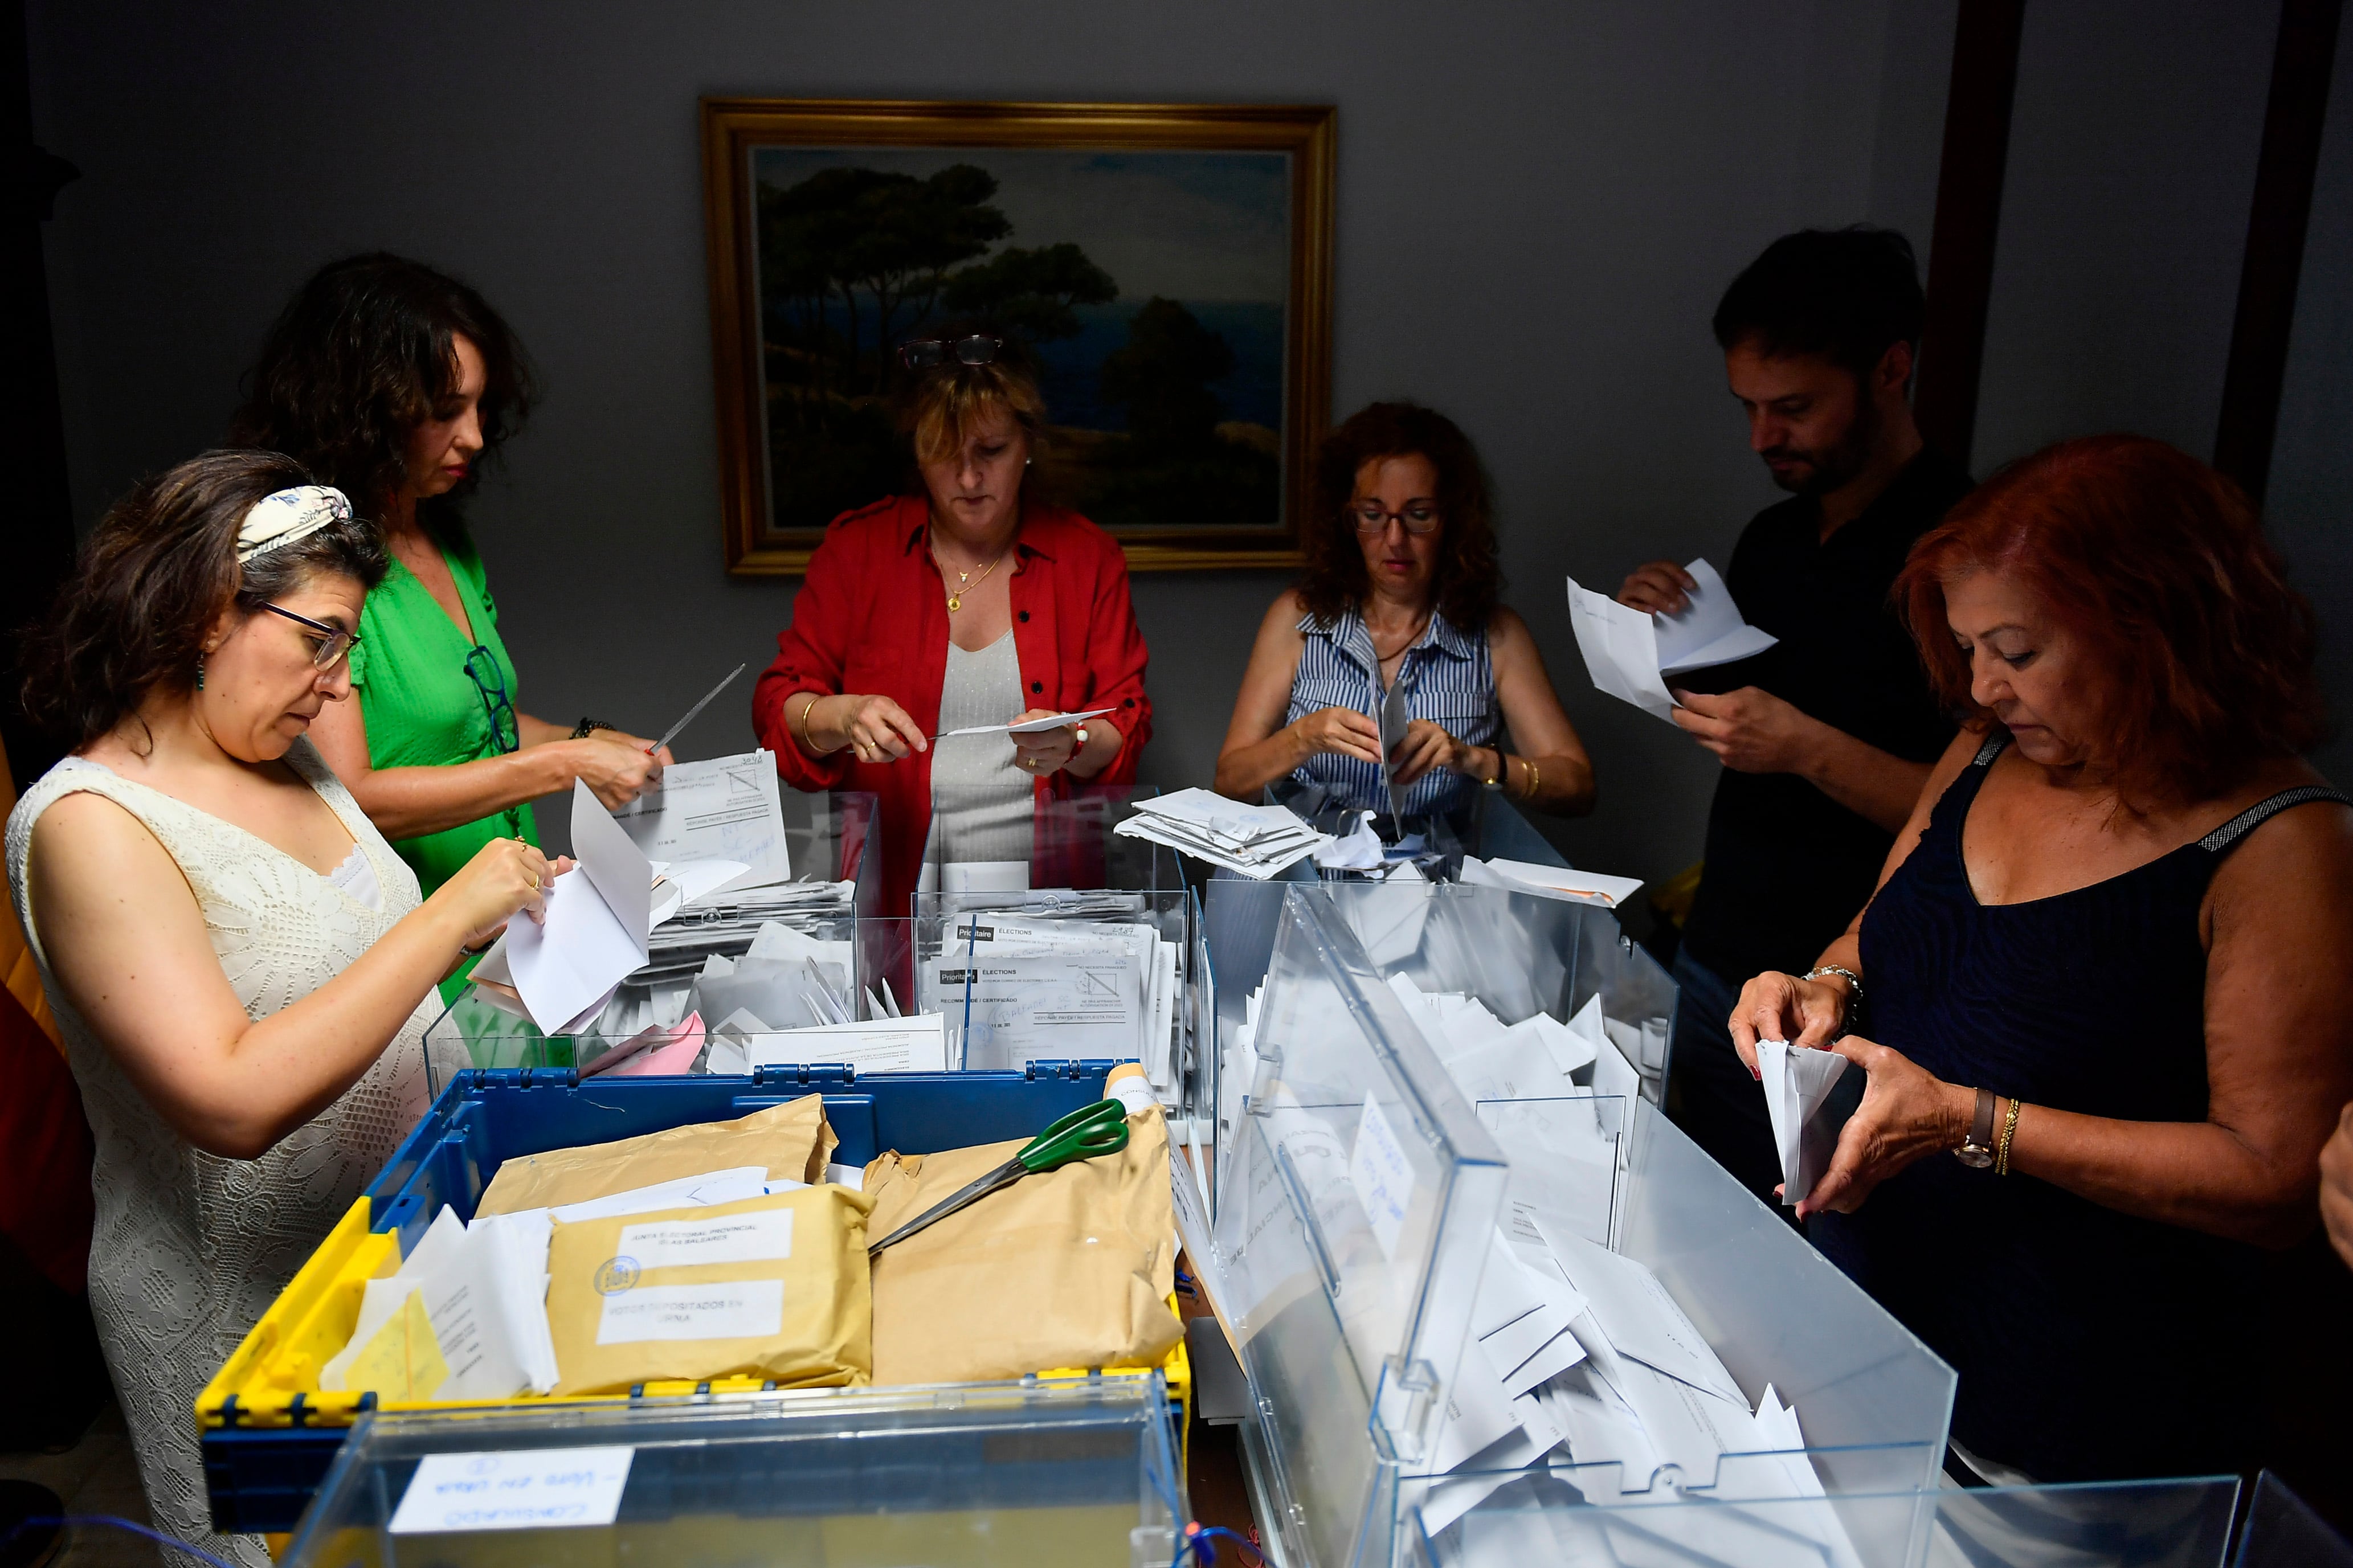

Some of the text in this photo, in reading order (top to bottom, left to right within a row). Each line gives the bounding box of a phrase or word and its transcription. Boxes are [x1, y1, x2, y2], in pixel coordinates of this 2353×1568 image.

[634, 807, 668, 817] CERTIFICADO
[631, 1231, 656, 1242] JUNTA
[710, 1223, 757, 1235] PROVINCIAL
[684, 1234, 729, 1246] BALEARES
